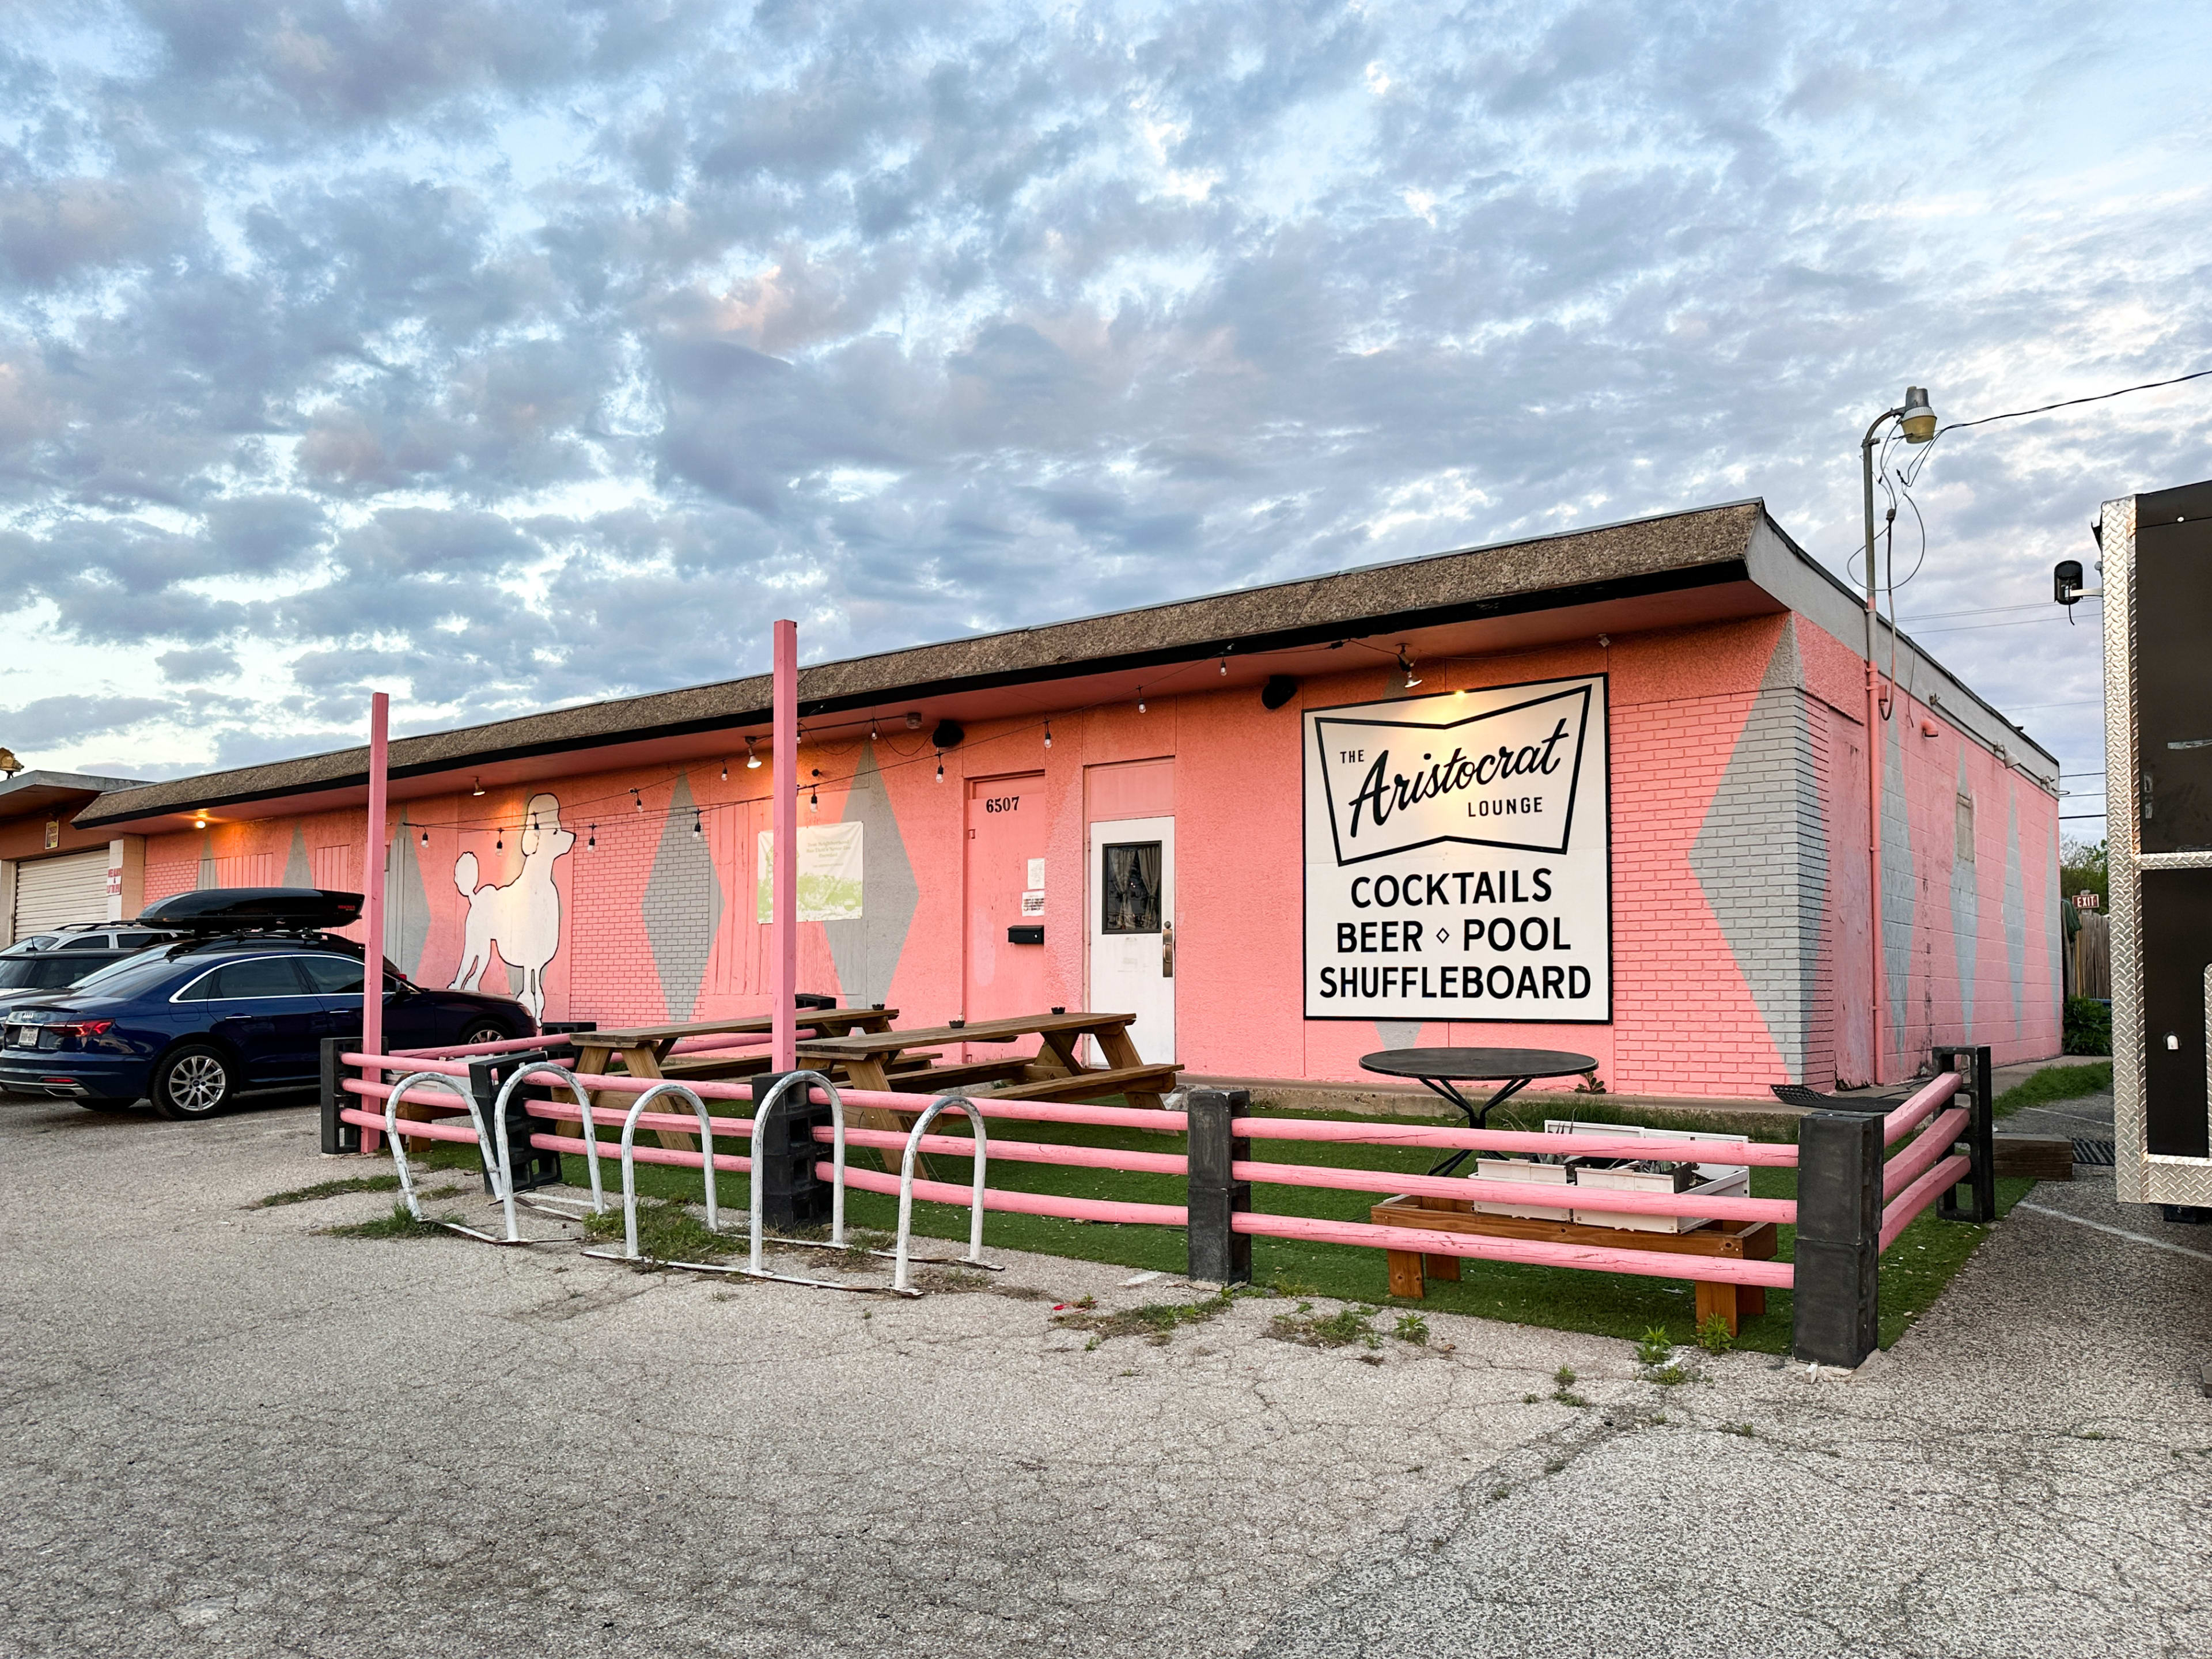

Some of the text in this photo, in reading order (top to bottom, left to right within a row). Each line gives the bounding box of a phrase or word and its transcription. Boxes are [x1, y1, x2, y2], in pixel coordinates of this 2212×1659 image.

[1340, 749, 1365, 764] THE
[1348, 718, 1569, 838] Aristocrat
[986, 796, 1020, 813] 6507
[1468, 797, 1543, 817] LOUNGE
[1350, 868, 1552, 908] COCKTAILS
[2077, 896, 2094, 907] EXIT
[1337, 916, 1571, 953] BEER POOL
[1319, 965, 1592, 1000] SHUFFLEBOARD
